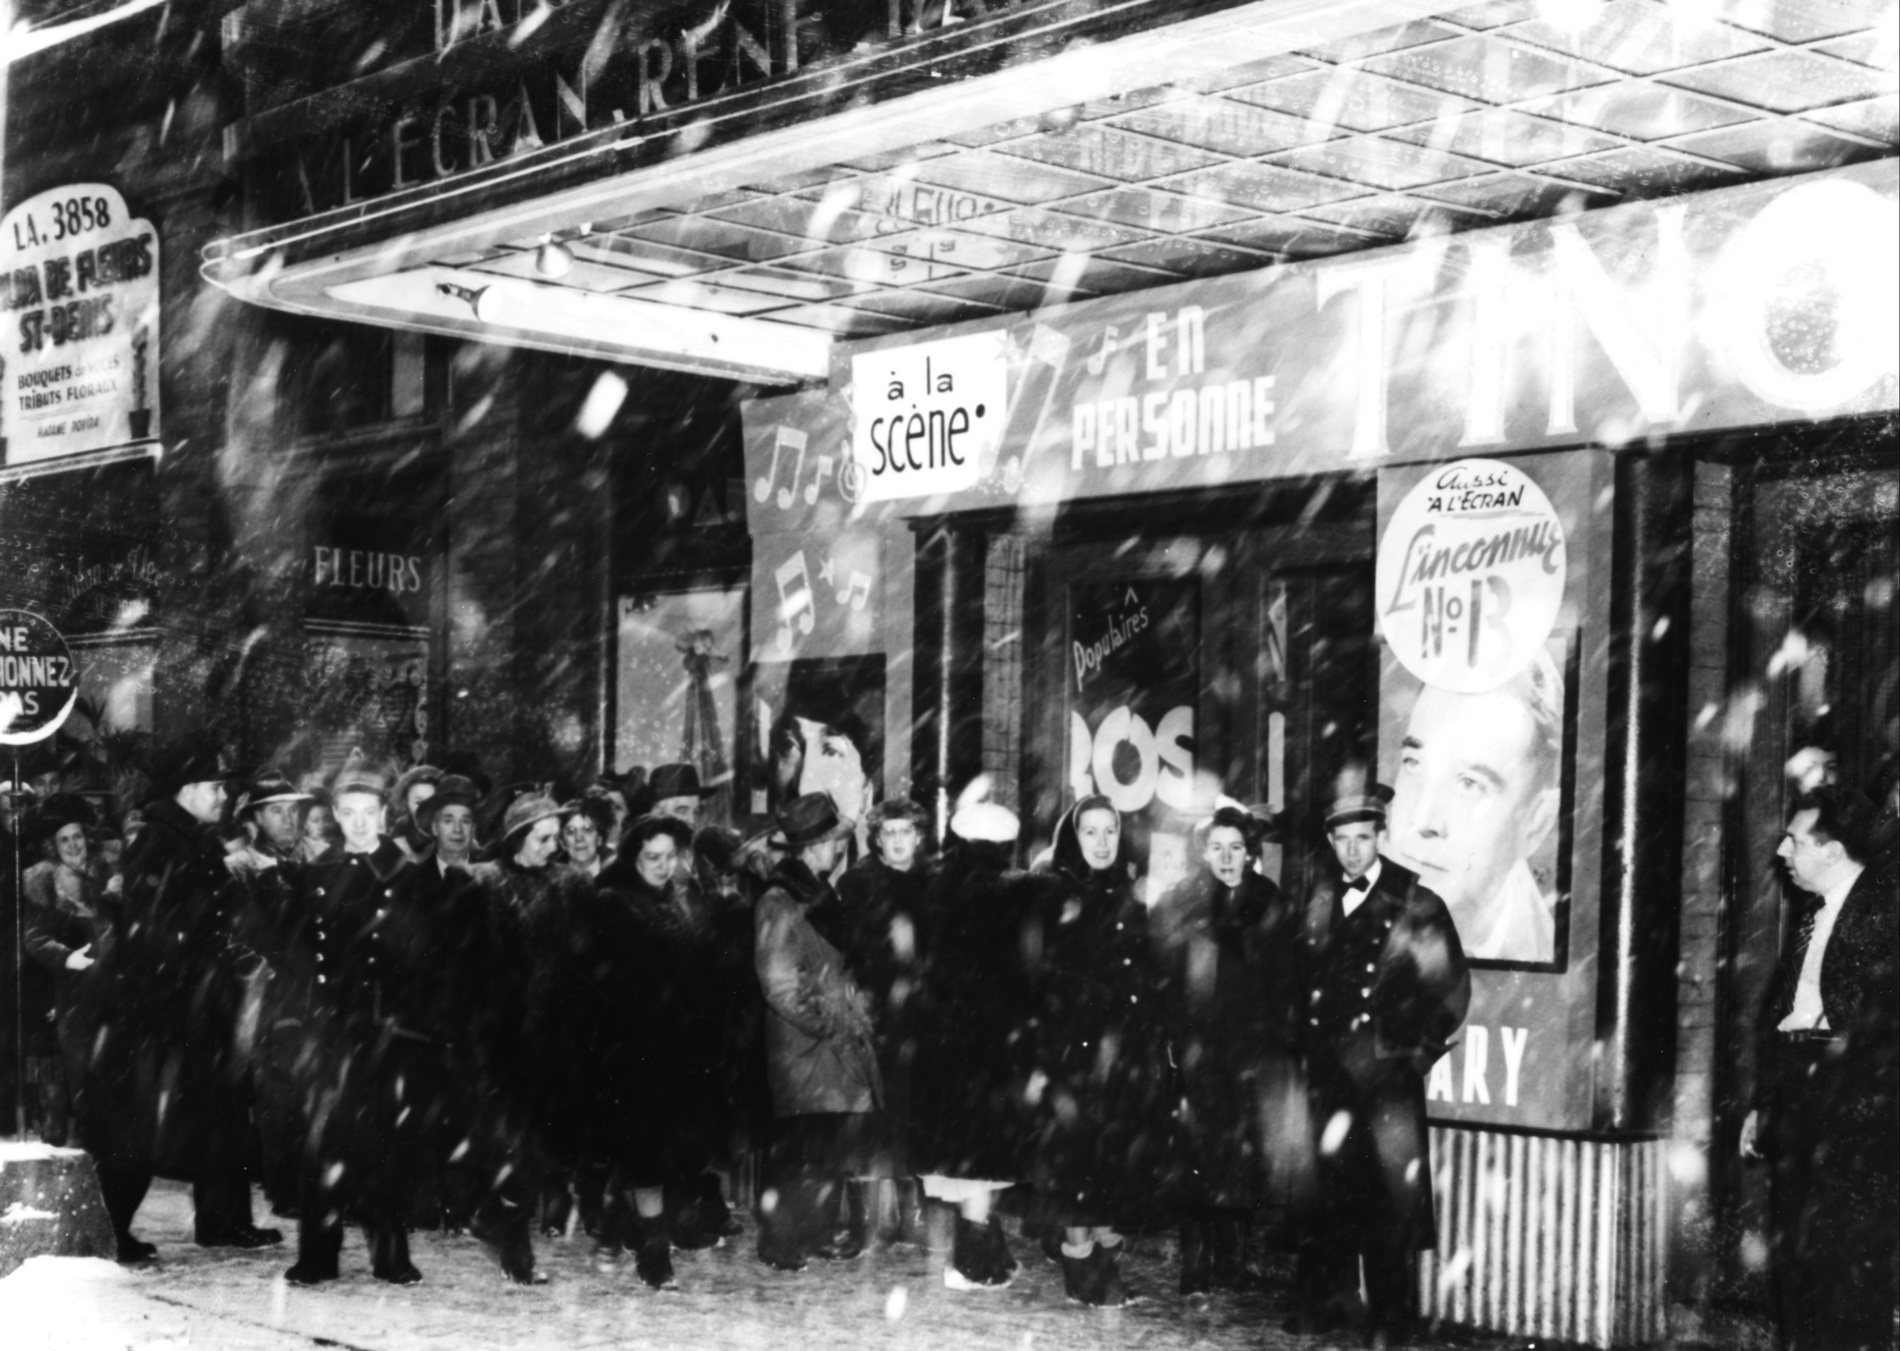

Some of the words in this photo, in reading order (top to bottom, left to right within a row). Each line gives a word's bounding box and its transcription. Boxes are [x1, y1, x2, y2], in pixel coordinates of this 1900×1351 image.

[14, 213, 48, 251] LA.
[52, 196, 111, 241] 3858
[43, 256, 74, 300] DE
[1147, 305, 1205, 380] EN
[1316, 177, 1899, 461] TINO
[18, 364, 73, 390] BOUQUETS
[887, 370, 904, 400] à
[925, 356, 954, 396] la
[1071, 375, 1276, 470] PERSONNE
[1436, 466, 1509, 490] Aussi
[313, 545, 422, 594] FLEURS
[1073, 606, 1150, 692] Populaires
